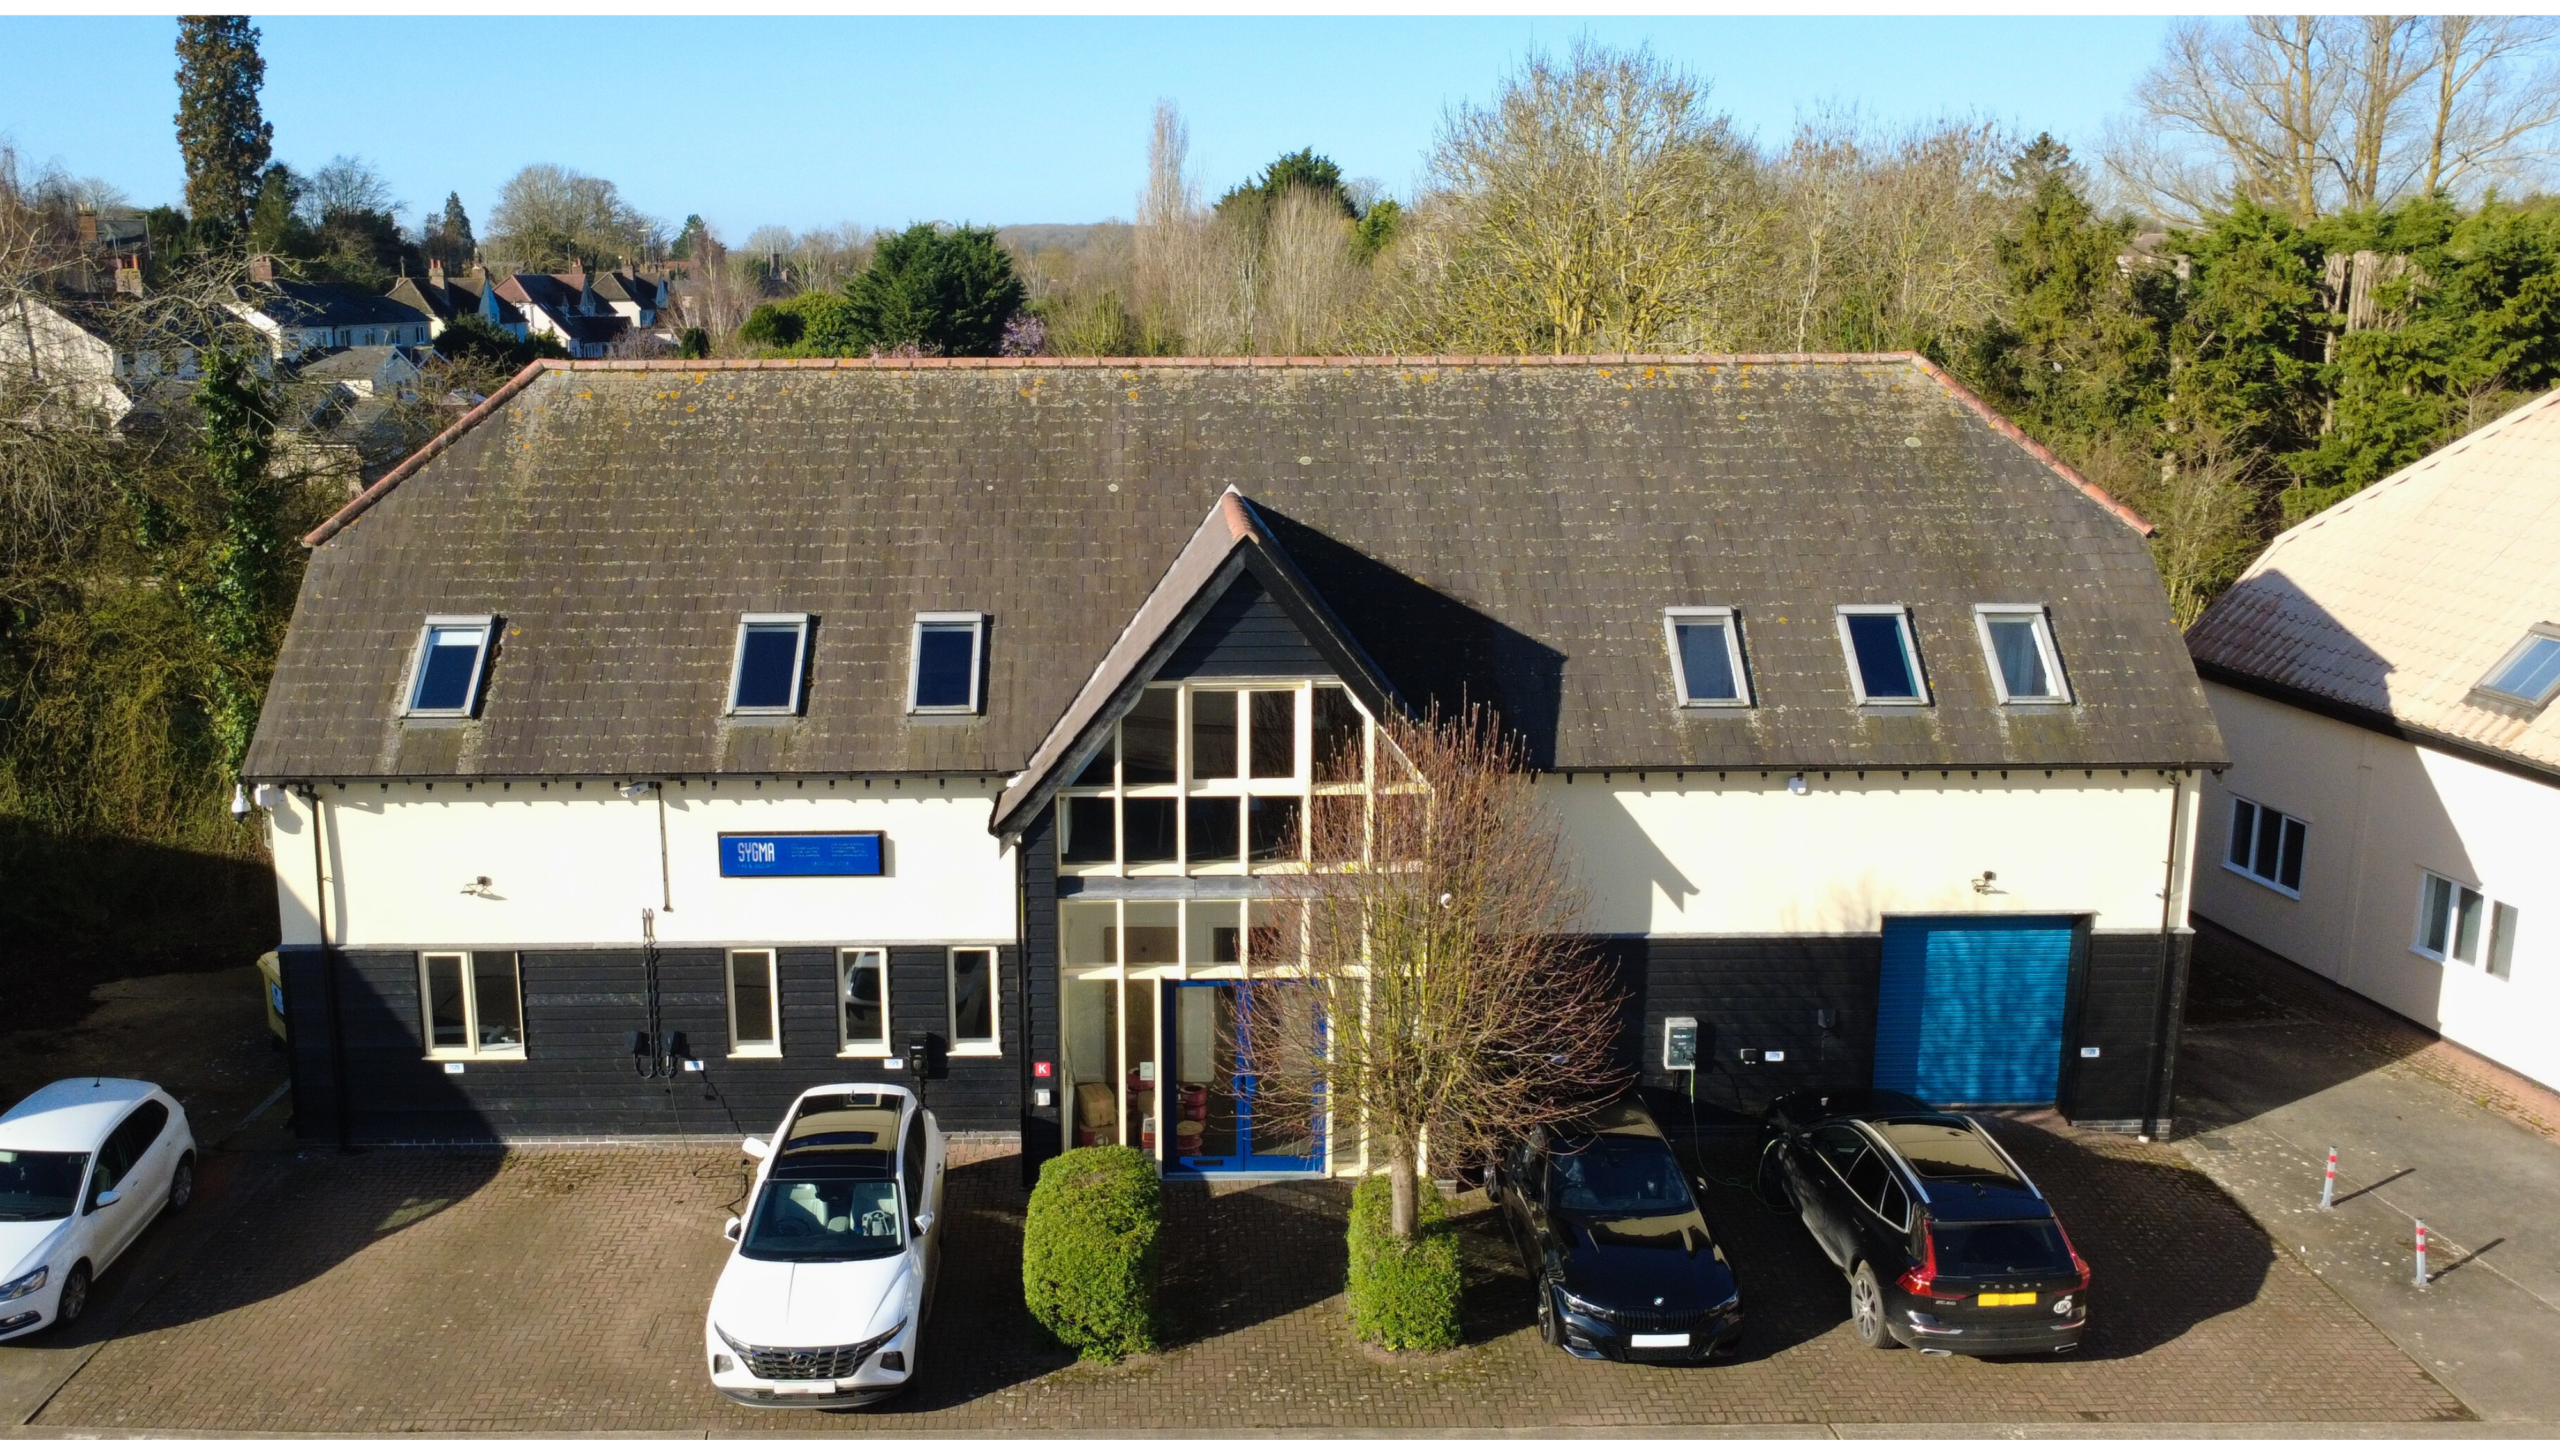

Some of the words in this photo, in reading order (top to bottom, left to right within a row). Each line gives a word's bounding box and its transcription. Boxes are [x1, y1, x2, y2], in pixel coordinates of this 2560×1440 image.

[737, 842, 775, 862] SYGMA
[1038, 1064, 1047, 1074] K
[2056, 1302, 2069, 1312] UK
